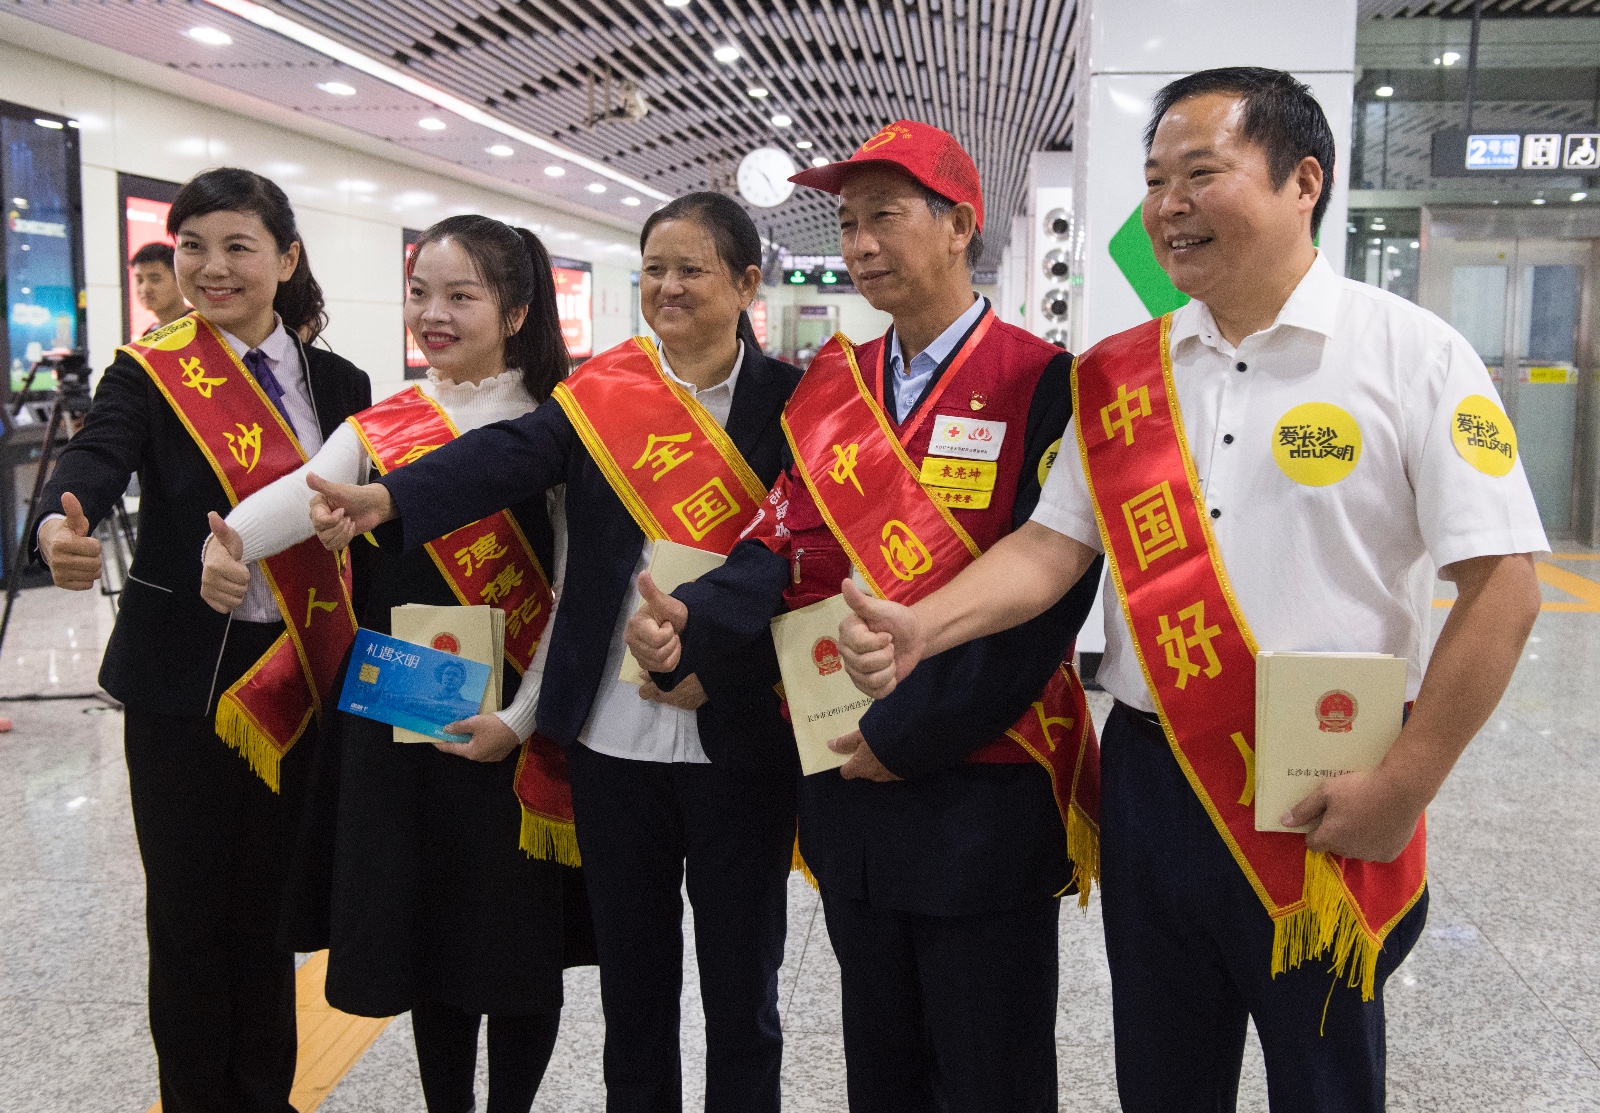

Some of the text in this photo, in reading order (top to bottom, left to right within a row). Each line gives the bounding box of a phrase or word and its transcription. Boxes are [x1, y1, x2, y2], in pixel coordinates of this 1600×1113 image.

[1278, 424, 1338, 448] 爱长沙
[1457, 413, 1499, 438] 爱长沙
[632, 431, 740, 541] 全国
[940, 465, 982, 483] 袁亮坤
[366, 642, 421, 669] 礼遇文明
